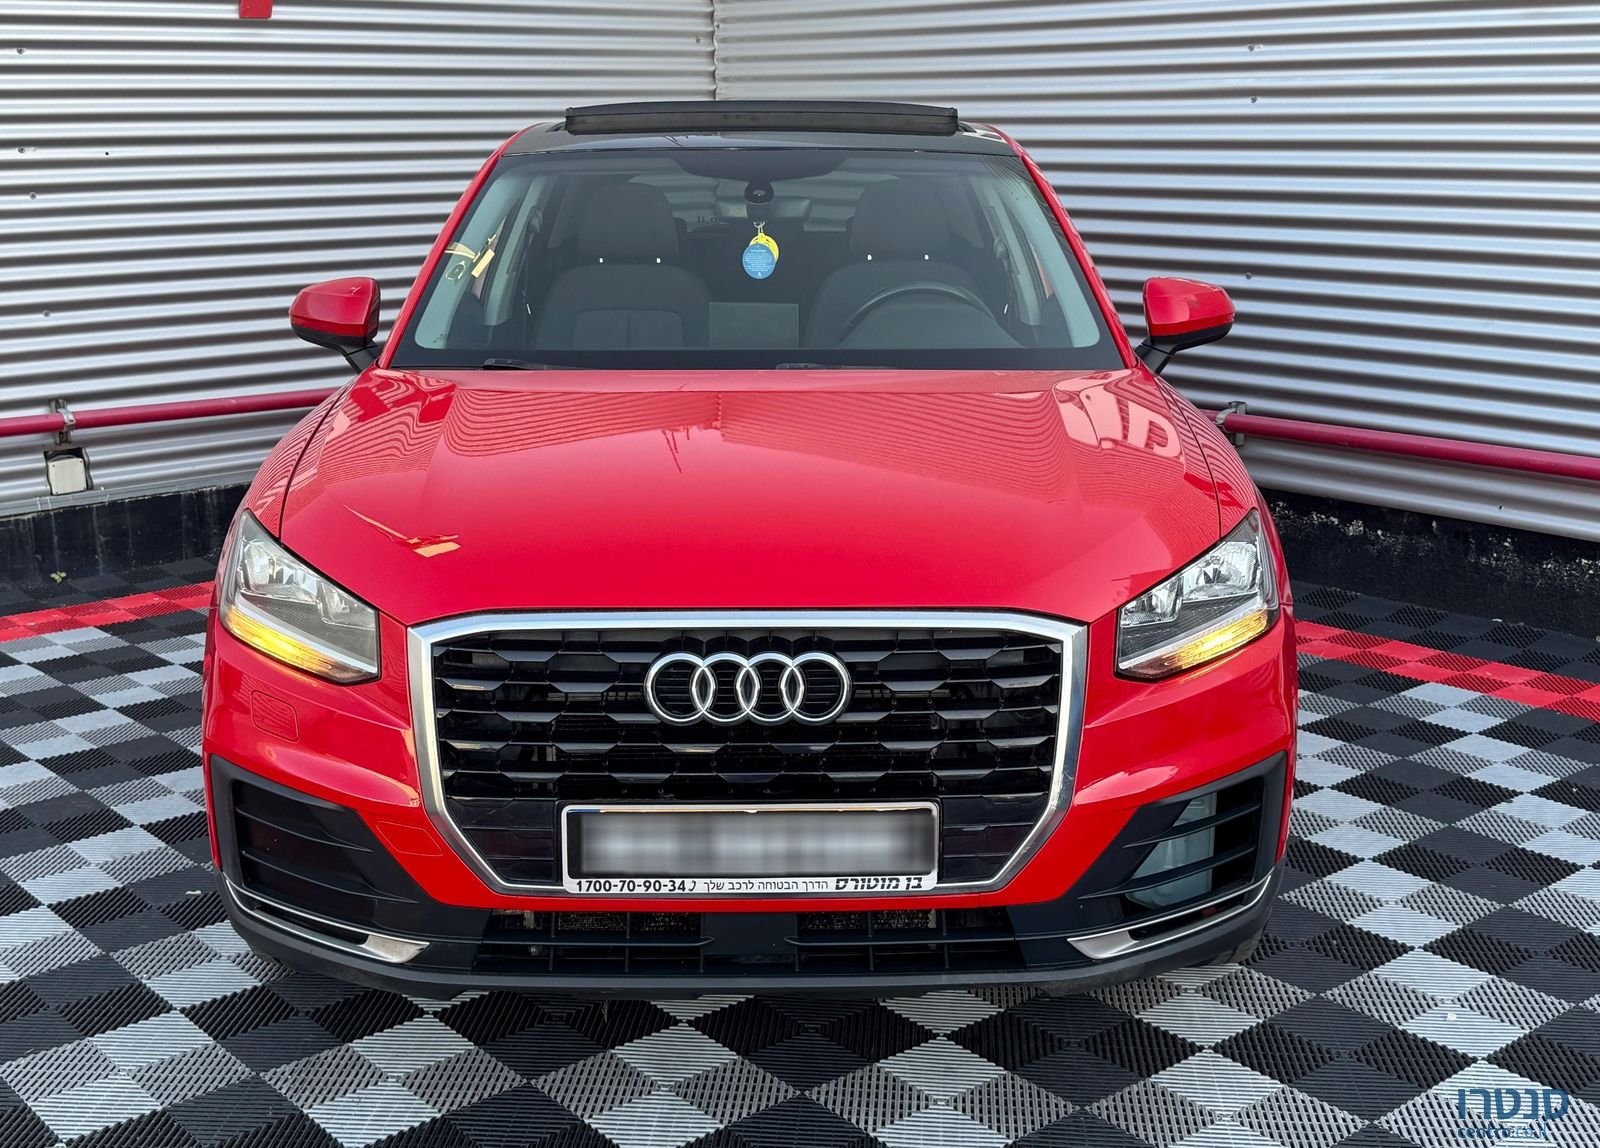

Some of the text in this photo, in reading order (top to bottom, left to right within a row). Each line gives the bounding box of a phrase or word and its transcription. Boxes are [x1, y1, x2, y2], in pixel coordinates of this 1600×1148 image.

[576, 876, 923, 893] בן מוטורס הדרך הבטוחה לרכב שלך 1700-70-90-34
